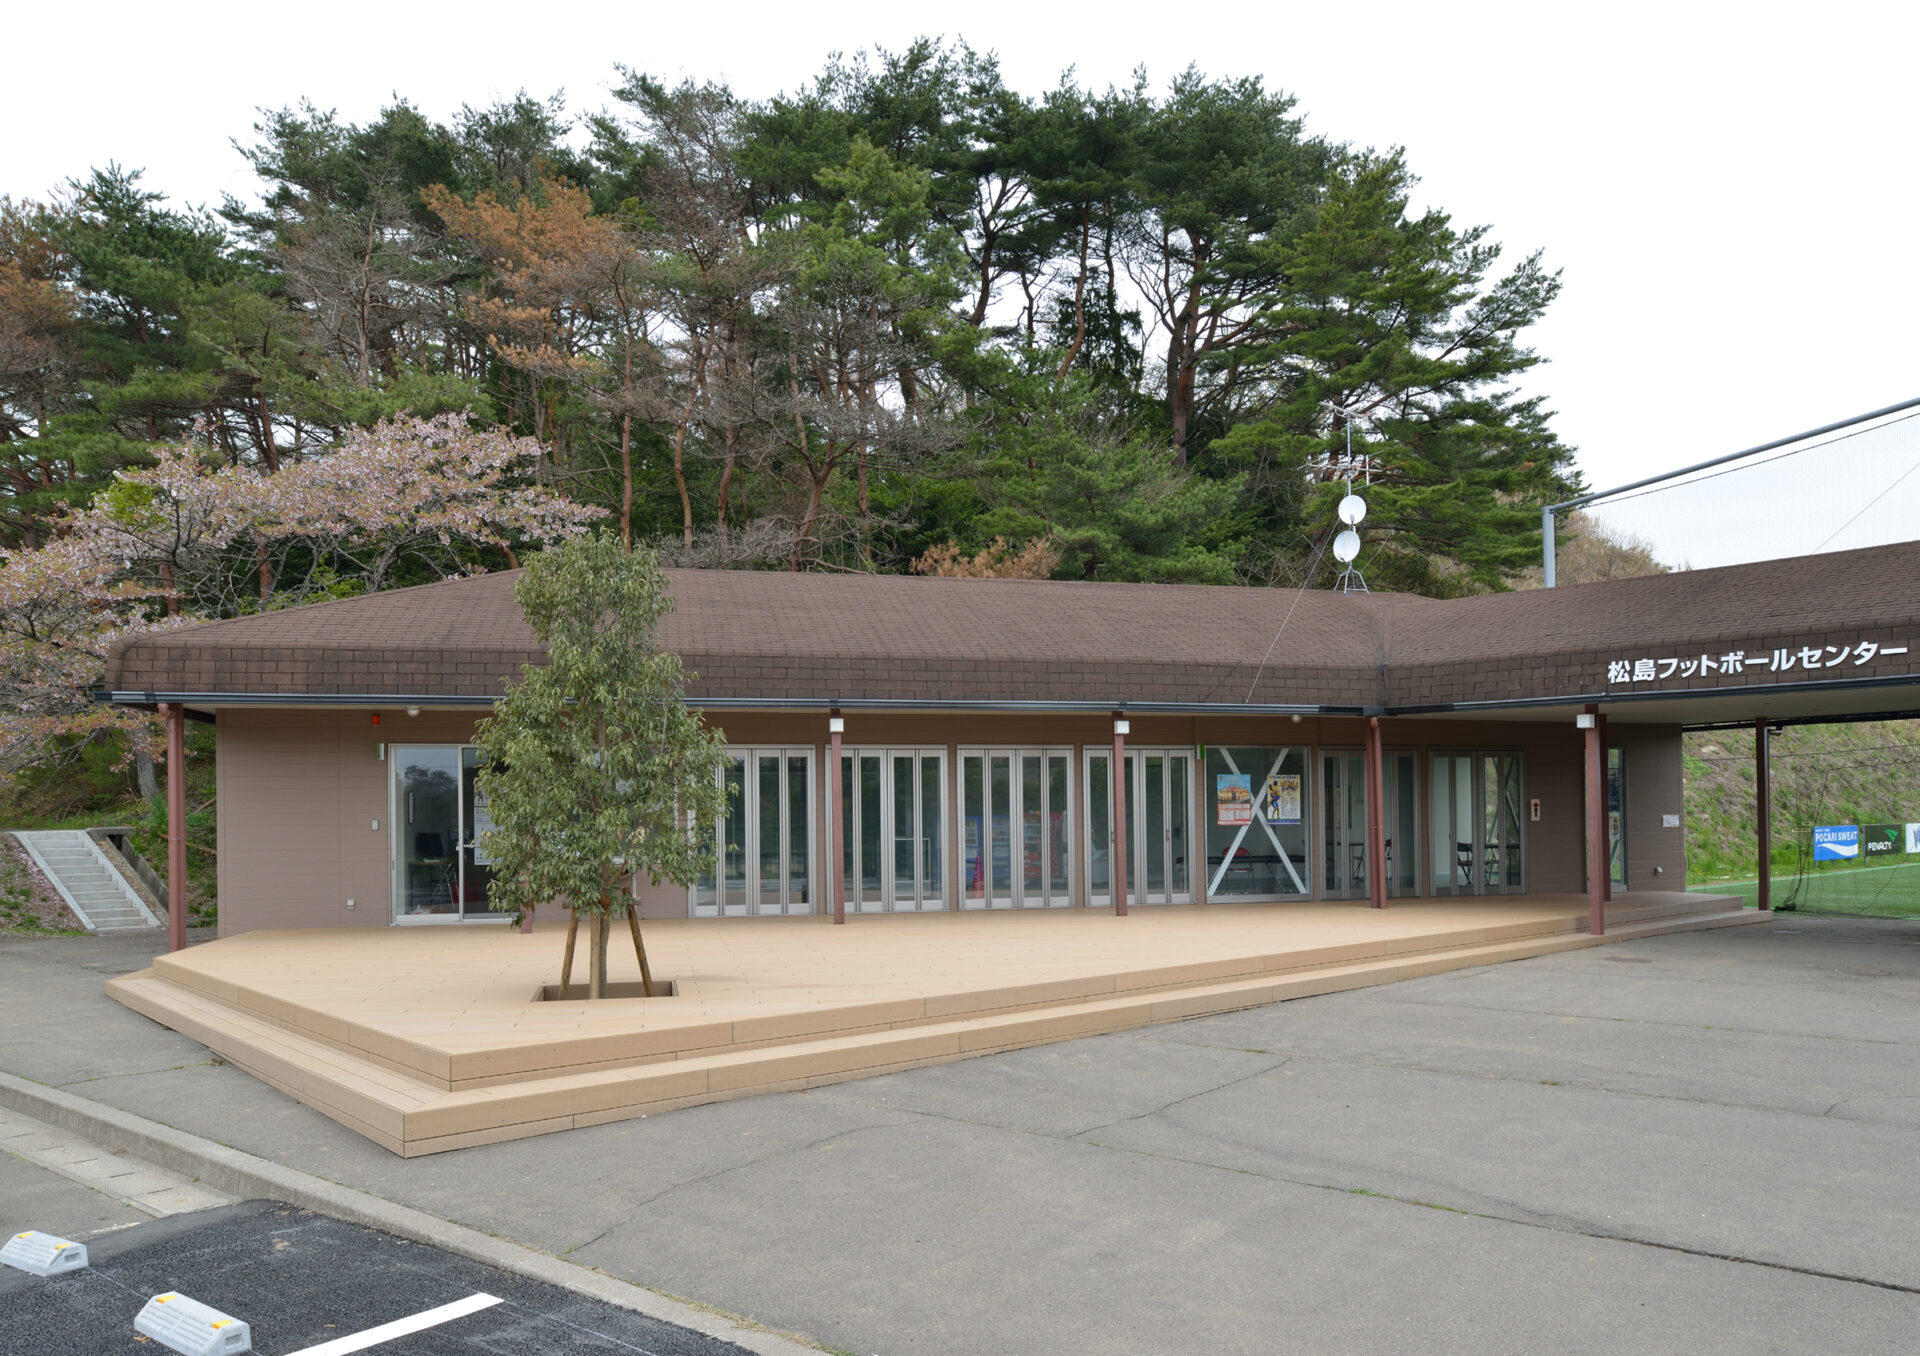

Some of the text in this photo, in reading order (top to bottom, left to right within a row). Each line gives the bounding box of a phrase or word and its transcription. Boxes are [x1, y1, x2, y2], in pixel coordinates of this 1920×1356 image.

[1607, 641, 1908, 683] 松島フットボールセンター
[1815, 831, 1857, 842] POCARI SWEAT
[1867, 841, 1892, 851] PENALTY
